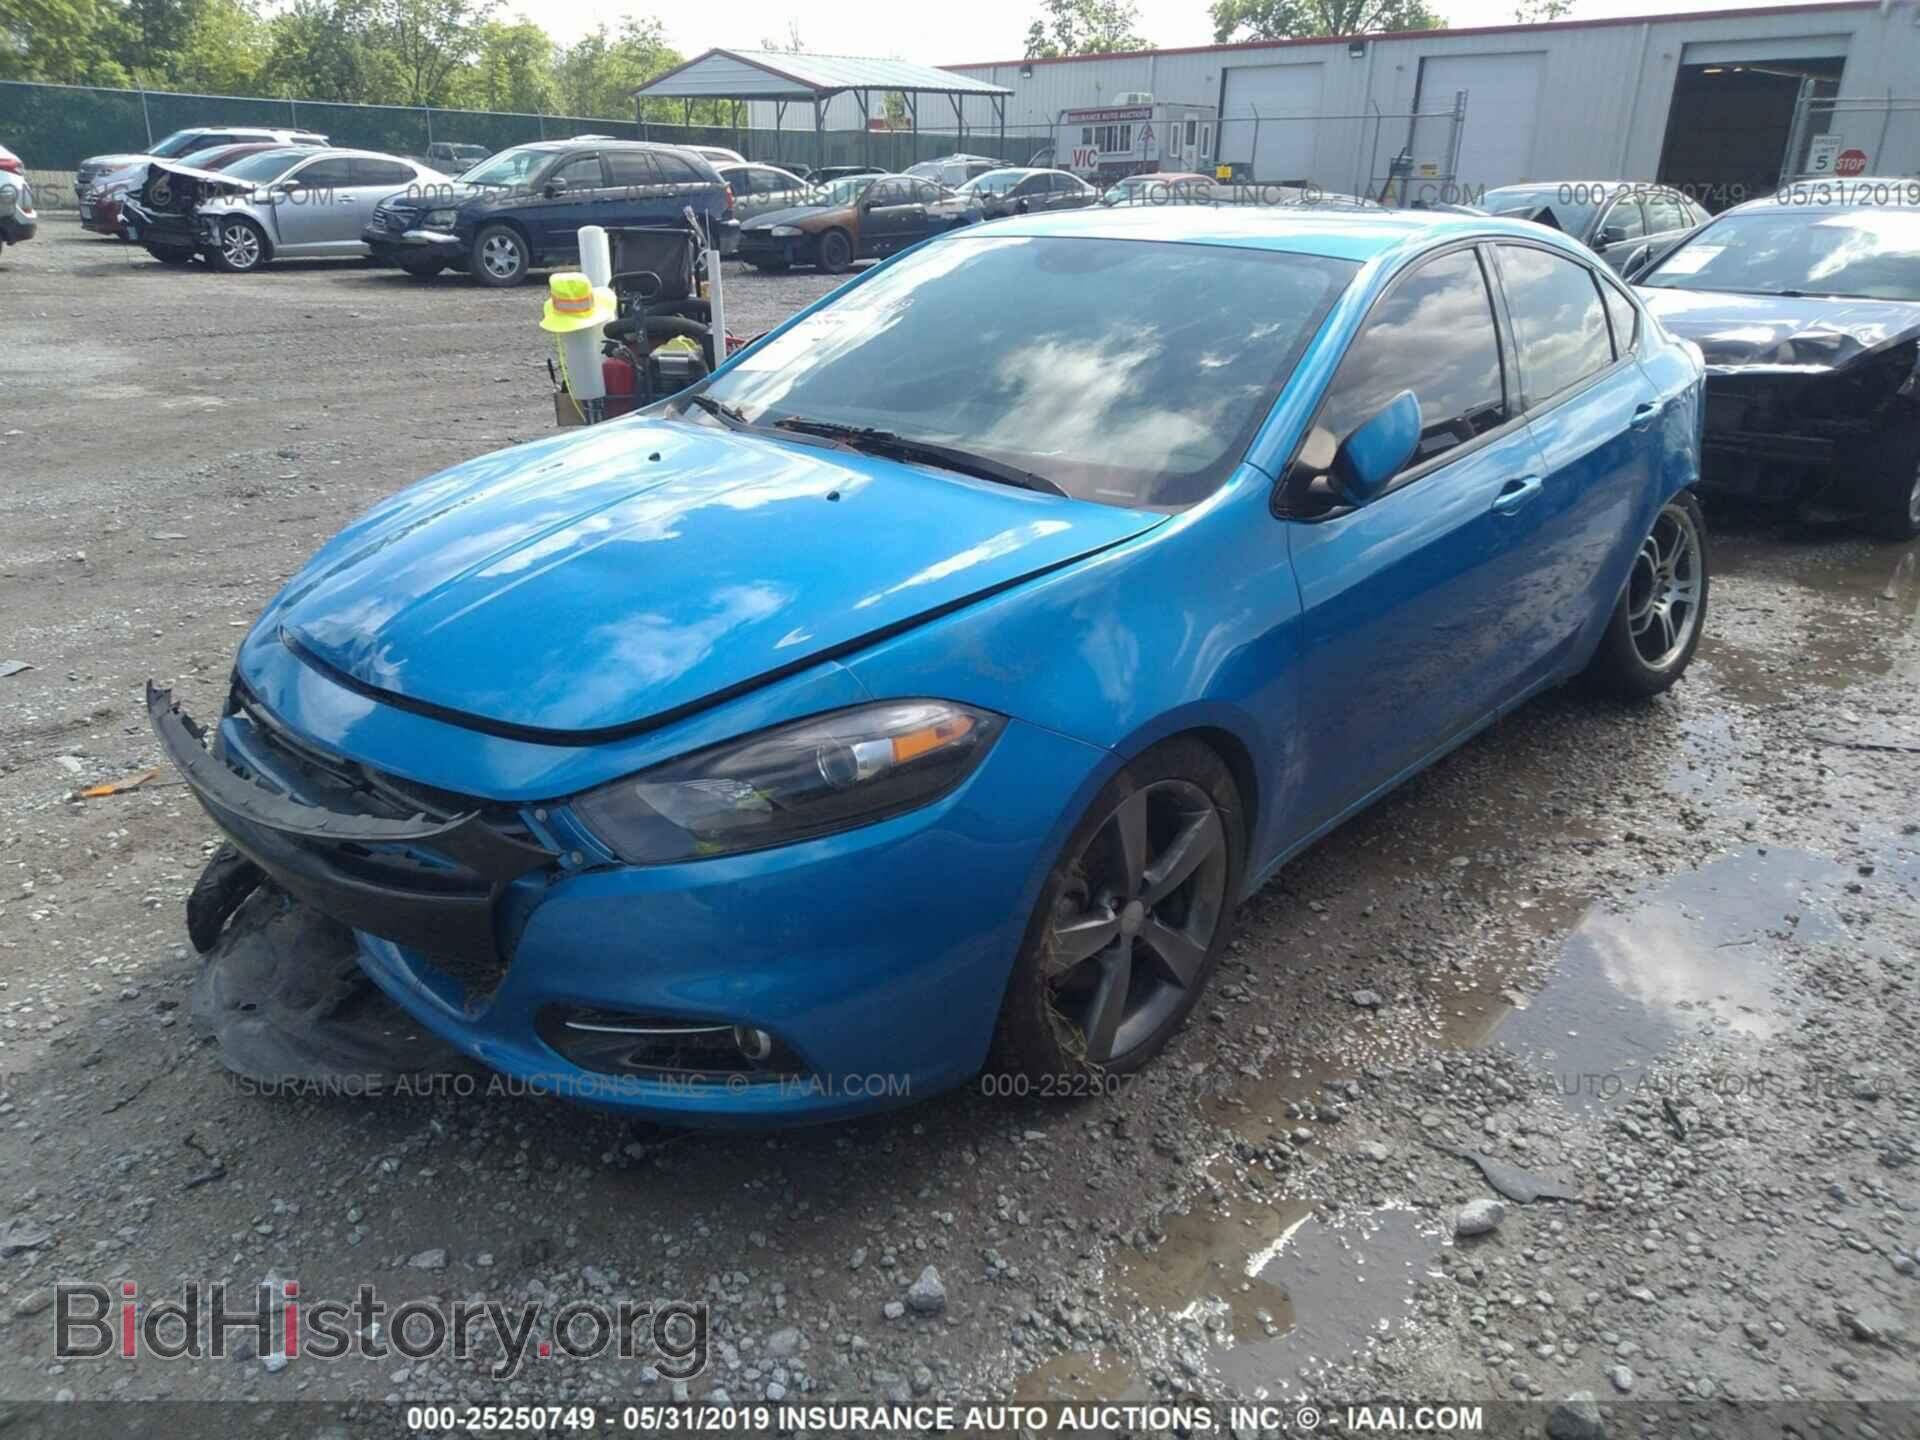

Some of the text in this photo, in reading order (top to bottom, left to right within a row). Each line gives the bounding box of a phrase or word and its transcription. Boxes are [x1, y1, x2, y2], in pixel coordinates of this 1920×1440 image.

[1072, 149, 1097, 168] VIC
[1815, 155, 1828, 170] 5
[1835, 158, 1866, 170] STOP
